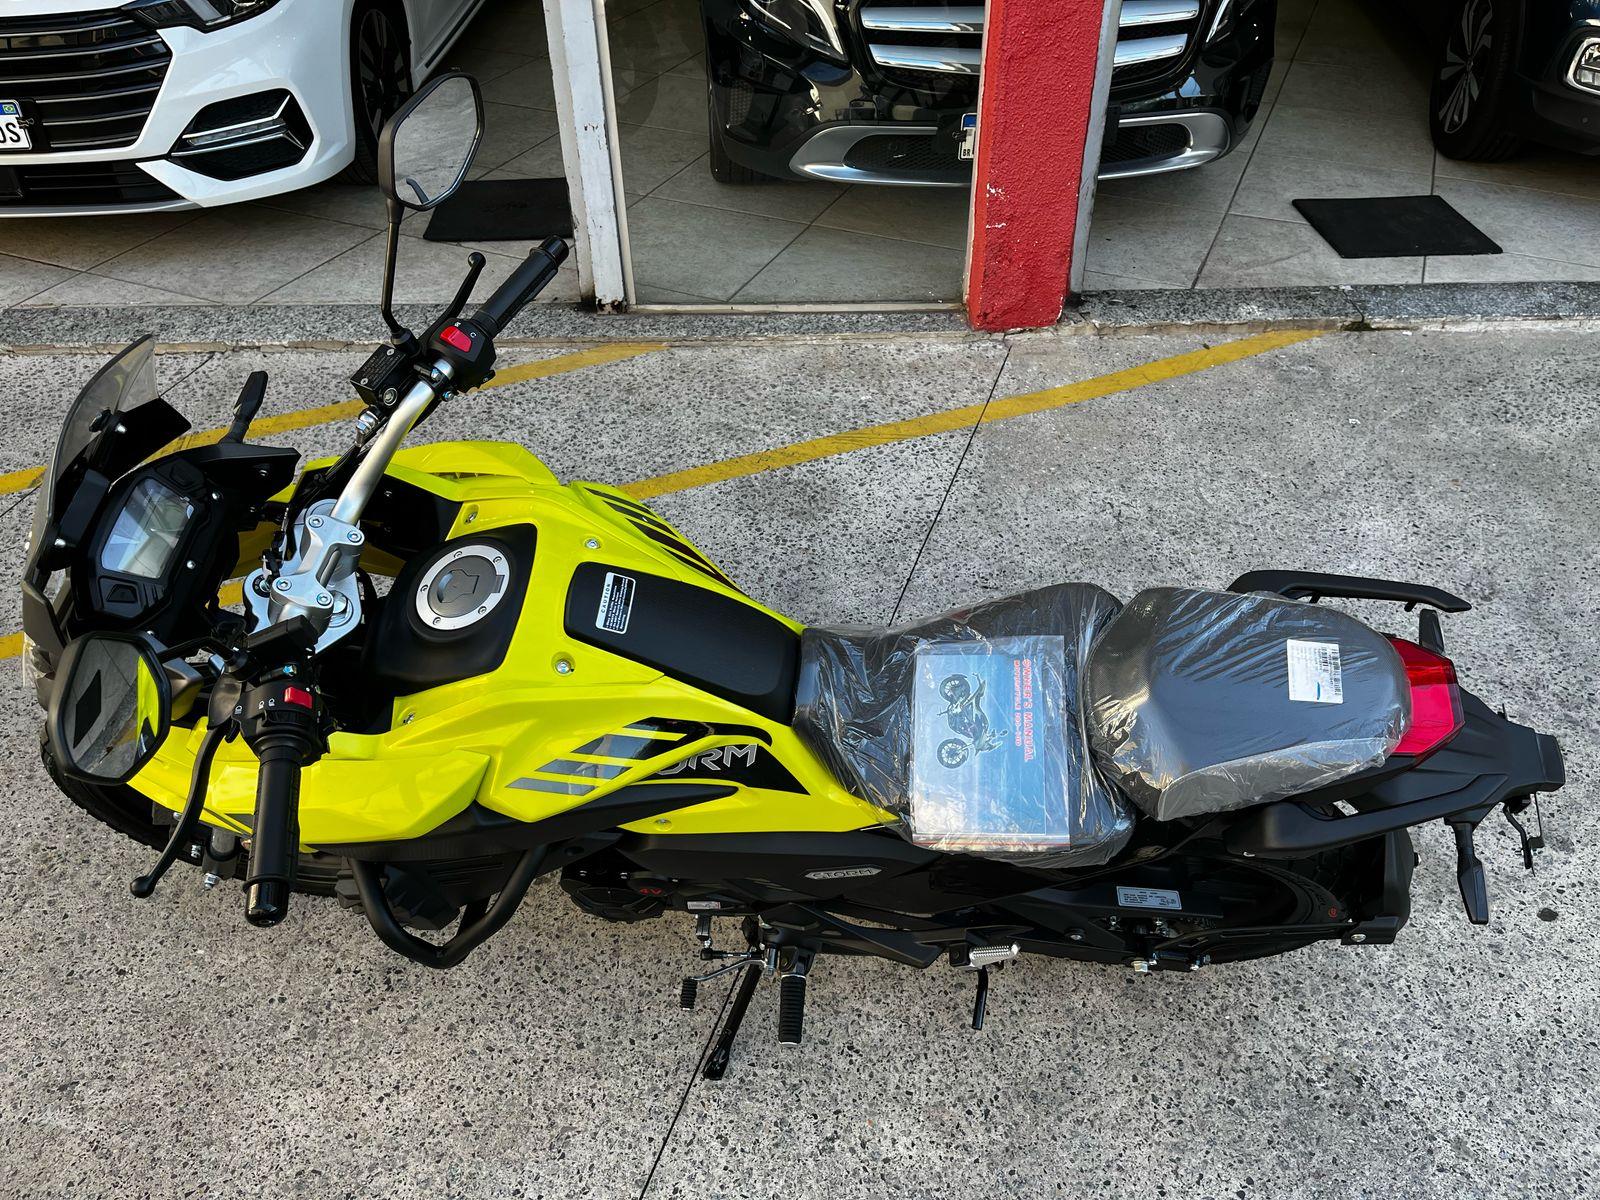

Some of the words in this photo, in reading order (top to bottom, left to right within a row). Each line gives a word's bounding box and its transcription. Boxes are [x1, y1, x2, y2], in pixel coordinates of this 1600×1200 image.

[962, 148, 971, 157] BR
[600, 583, 611, 614] CAUTION
[1023, 711, 1034, 762] MANUAL
